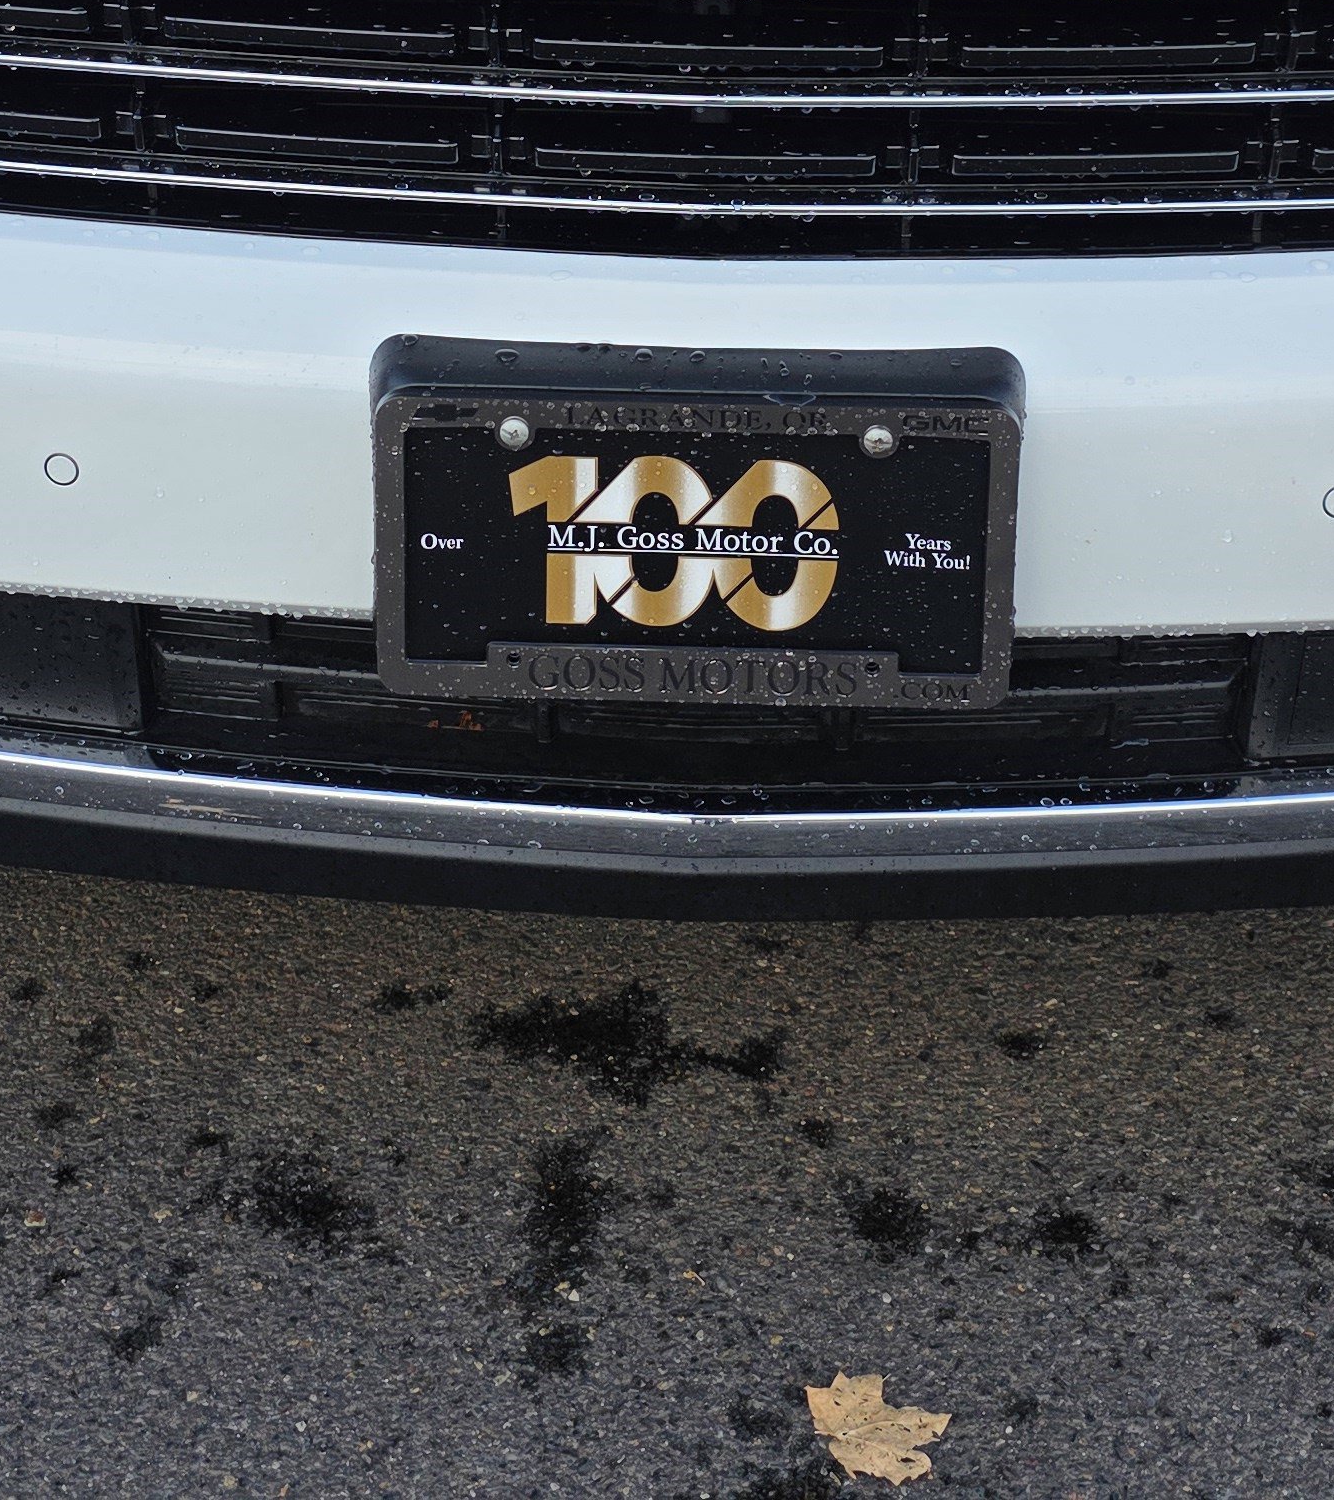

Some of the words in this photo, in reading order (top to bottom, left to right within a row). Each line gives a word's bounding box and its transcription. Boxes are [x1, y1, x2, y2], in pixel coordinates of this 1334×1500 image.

[902, 415, 989, 434] GMC
[420, 533, 464, 550] Over
[508, 455, 840, 632] 100
[547, 525, 605, 552] M.J.
[617, 526, 685, 550] Goss
[695, 528, 784, 553] Motor
[793, 531, 838, 555] Co.
[905, 533, 952, 552] Years
[884, 550, 926, 568] With
[931, 552, 971, 571] You!
[528, 653, 646, 693] GOSS
[660, 657, 858, 698] MOTORS
